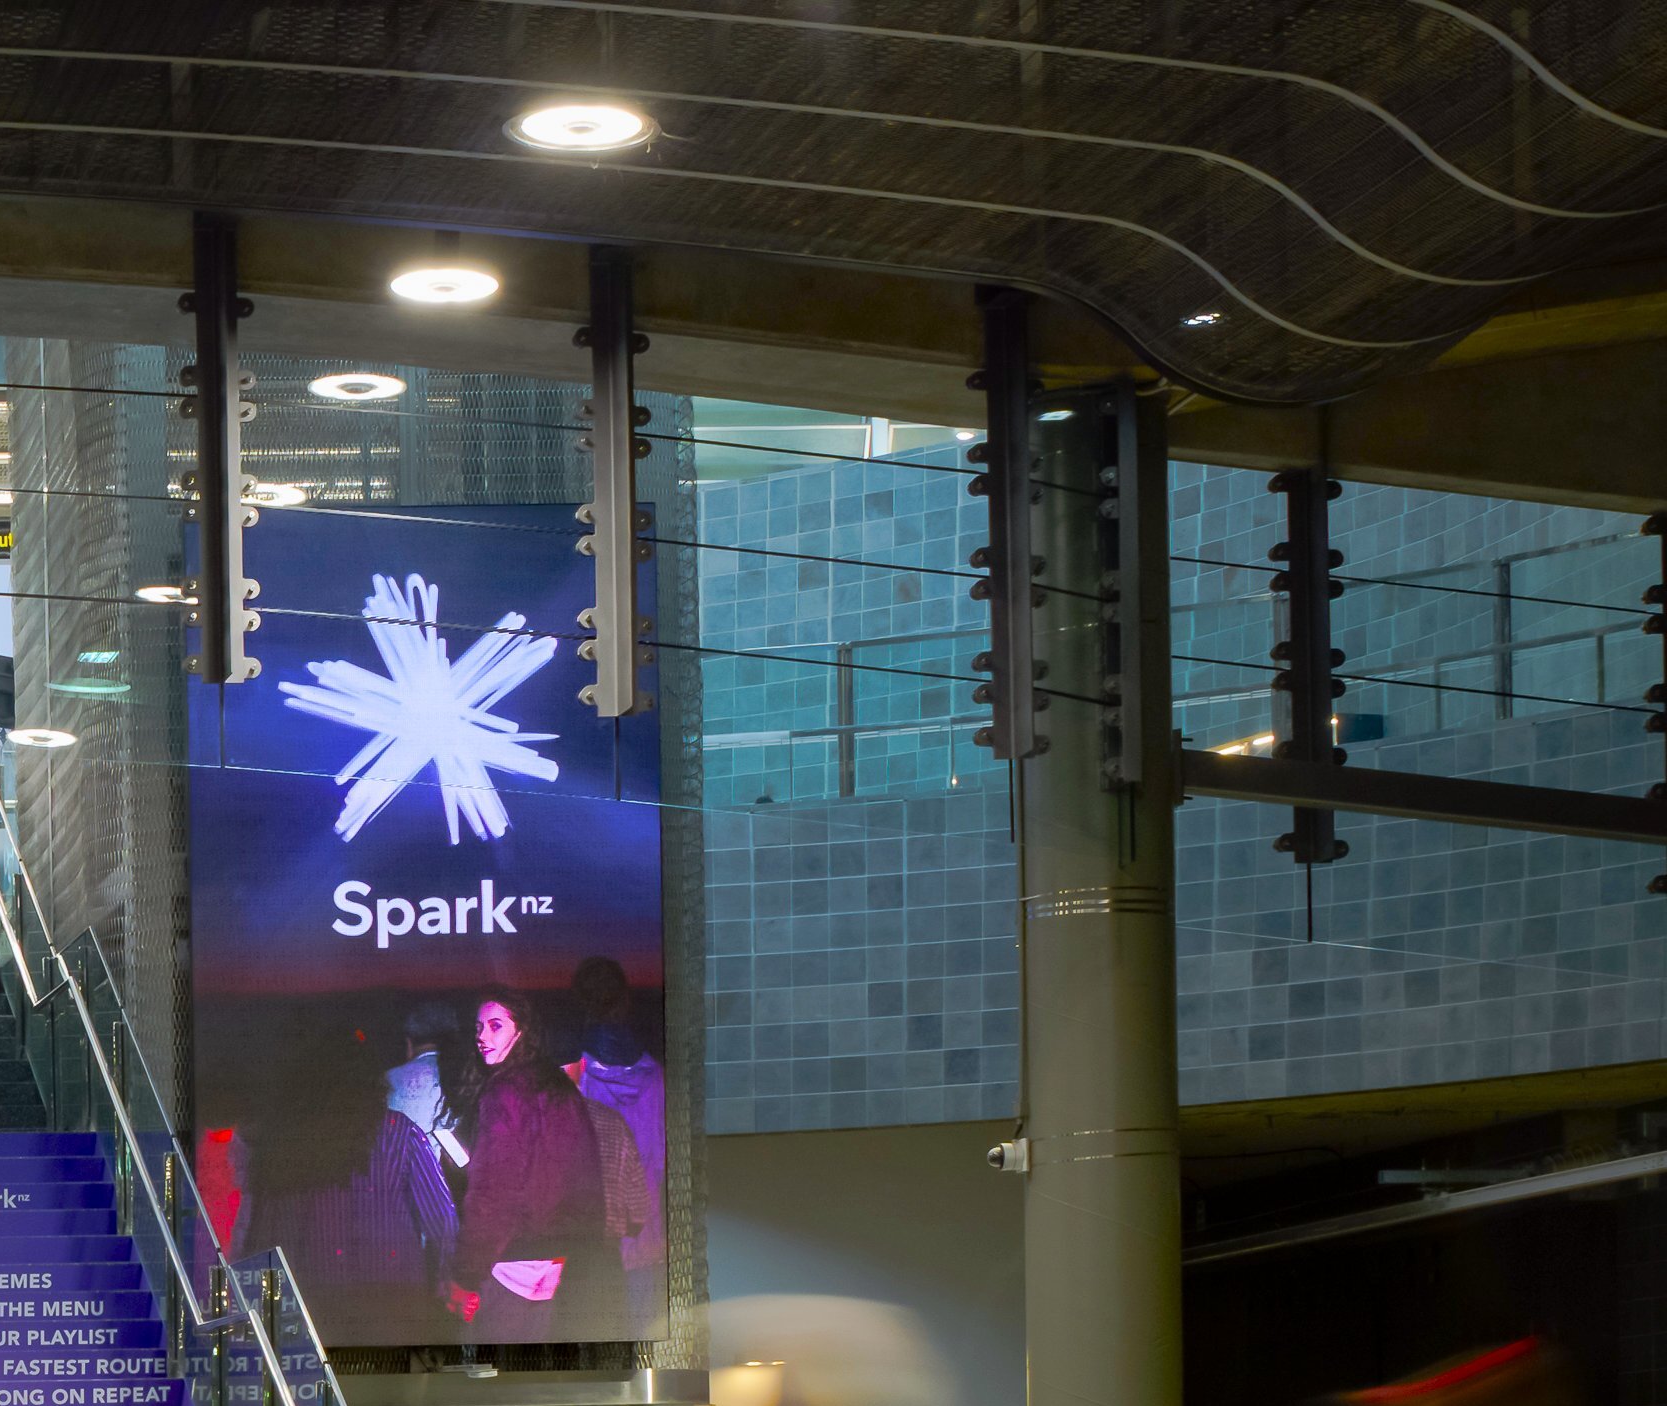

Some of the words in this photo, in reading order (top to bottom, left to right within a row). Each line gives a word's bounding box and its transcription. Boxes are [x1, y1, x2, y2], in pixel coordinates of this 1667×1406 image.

[42, 1300, 105, 1317] MENU
[27, 1328, 118, 1346] PLAYLIST
[3, 1358, 90, 1376] FASTEST
[96, 1356, 167, 1375] ROUTE
[51, 1387, 85, 1405] ON
[92, 1386, 171, 1404] REPEAT
